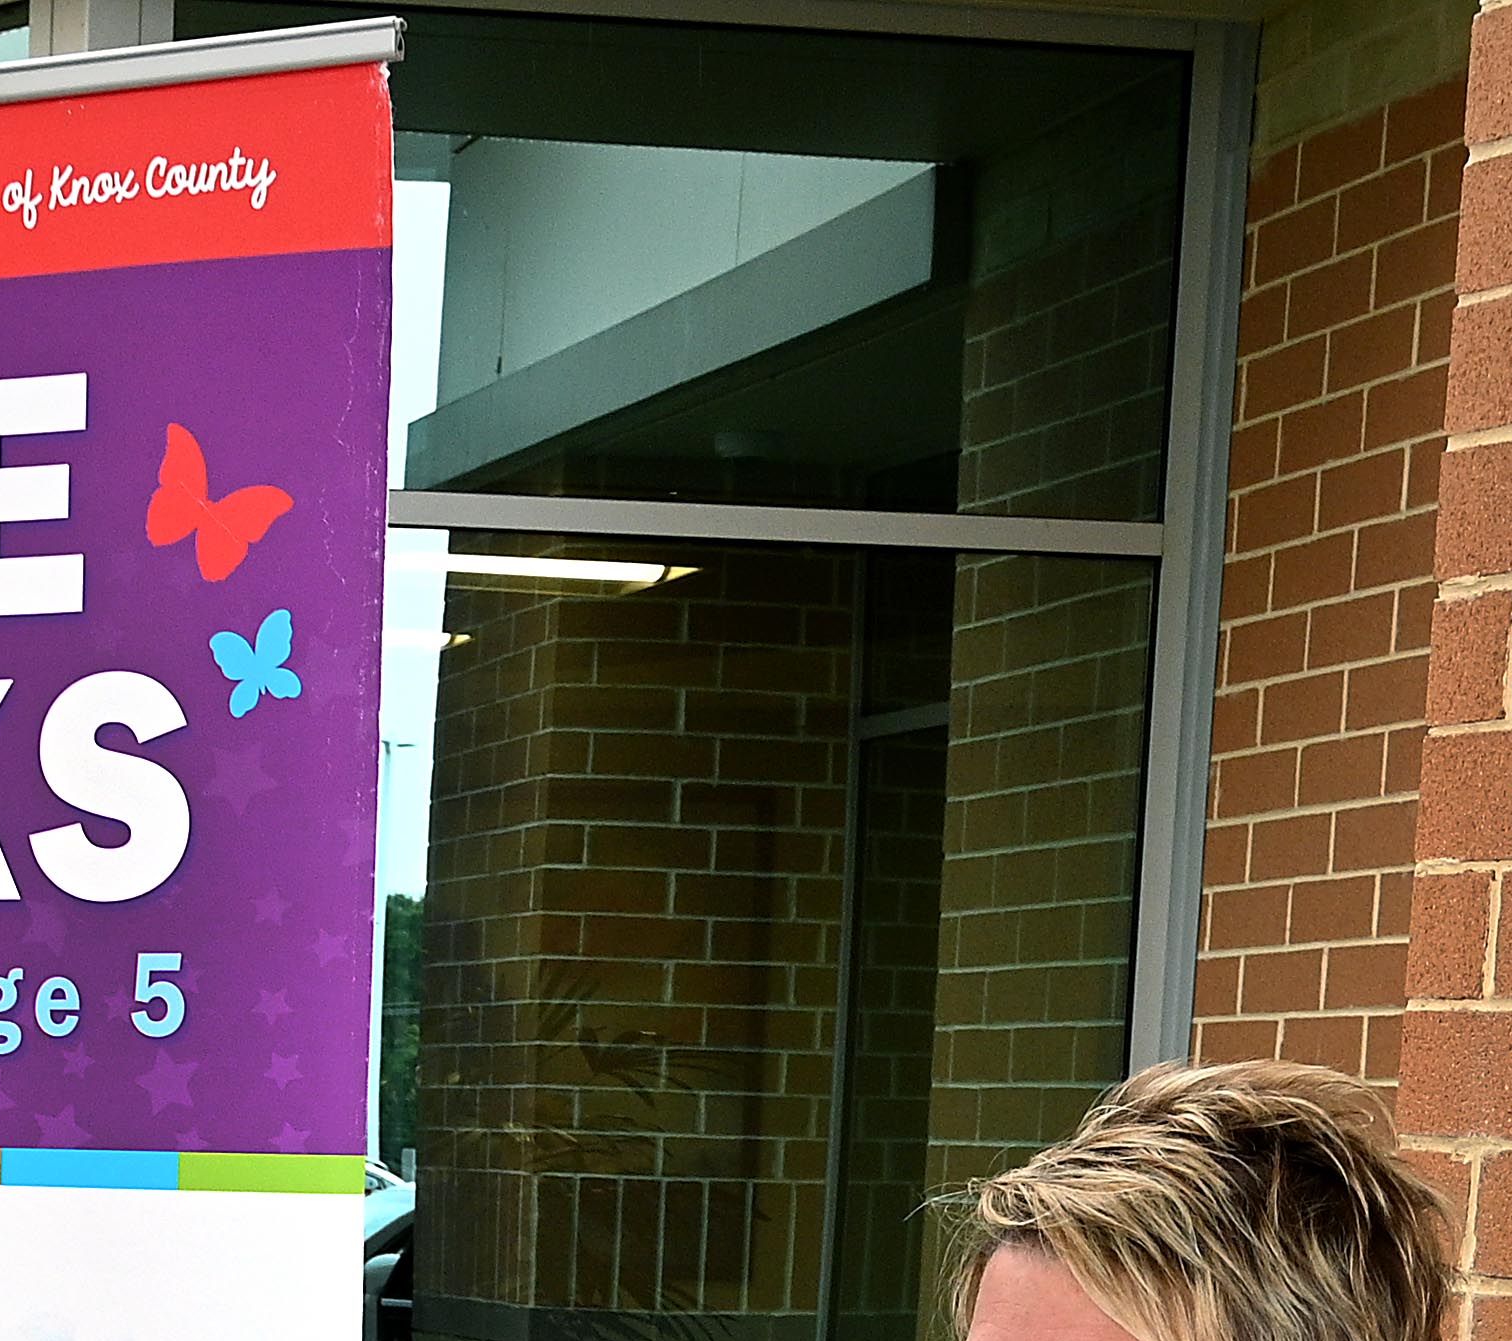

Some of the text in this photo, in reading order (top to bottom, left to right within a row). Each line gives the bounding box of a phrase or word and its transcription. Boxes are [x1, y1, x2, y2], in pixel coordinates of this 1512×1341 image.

[1, 169, 42, 226] of
[49, 160, 138, 213] Knox
[144, 149, 276, 208] County
[131, 953, 185, 1038] 5
